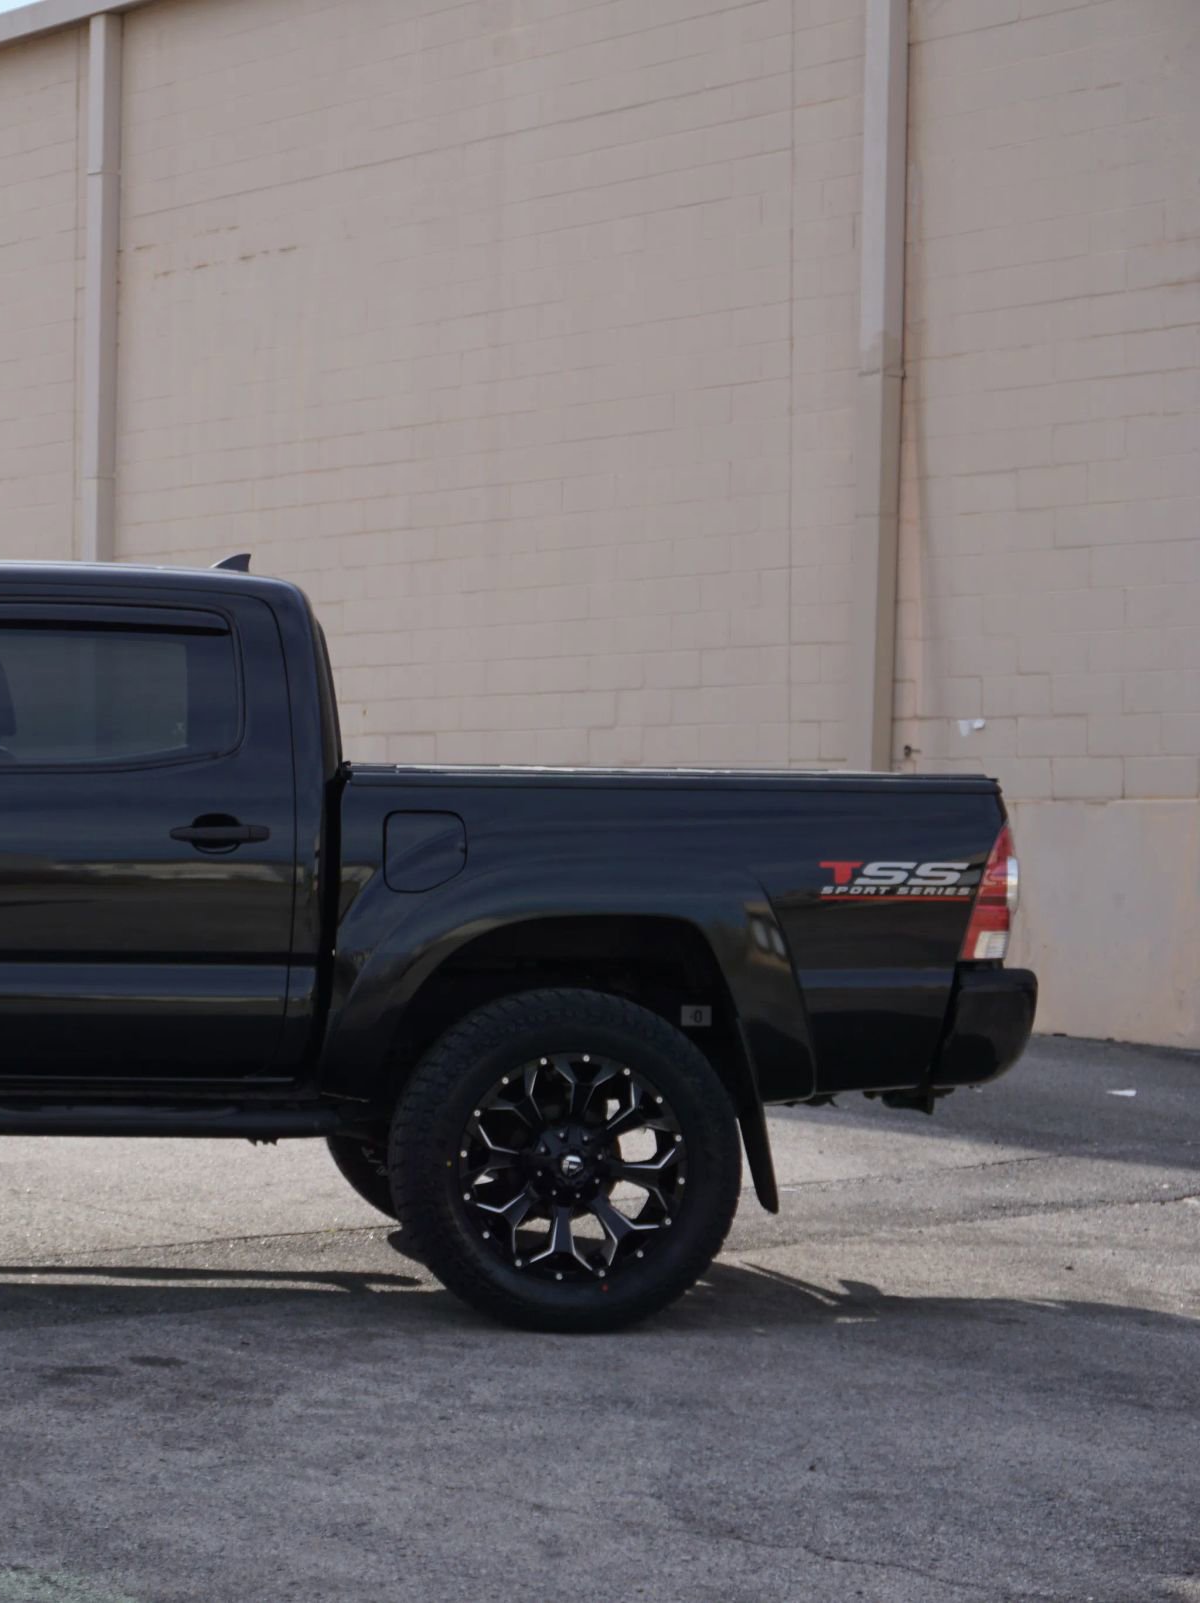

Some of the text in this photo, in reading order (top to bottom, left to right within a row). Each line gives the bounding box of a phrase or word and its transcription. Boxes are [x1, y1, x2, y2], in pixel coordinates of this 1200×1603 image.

[818, 860, 970, 886] TSS
[820, 886, 971, 896] SPORT SERIES
